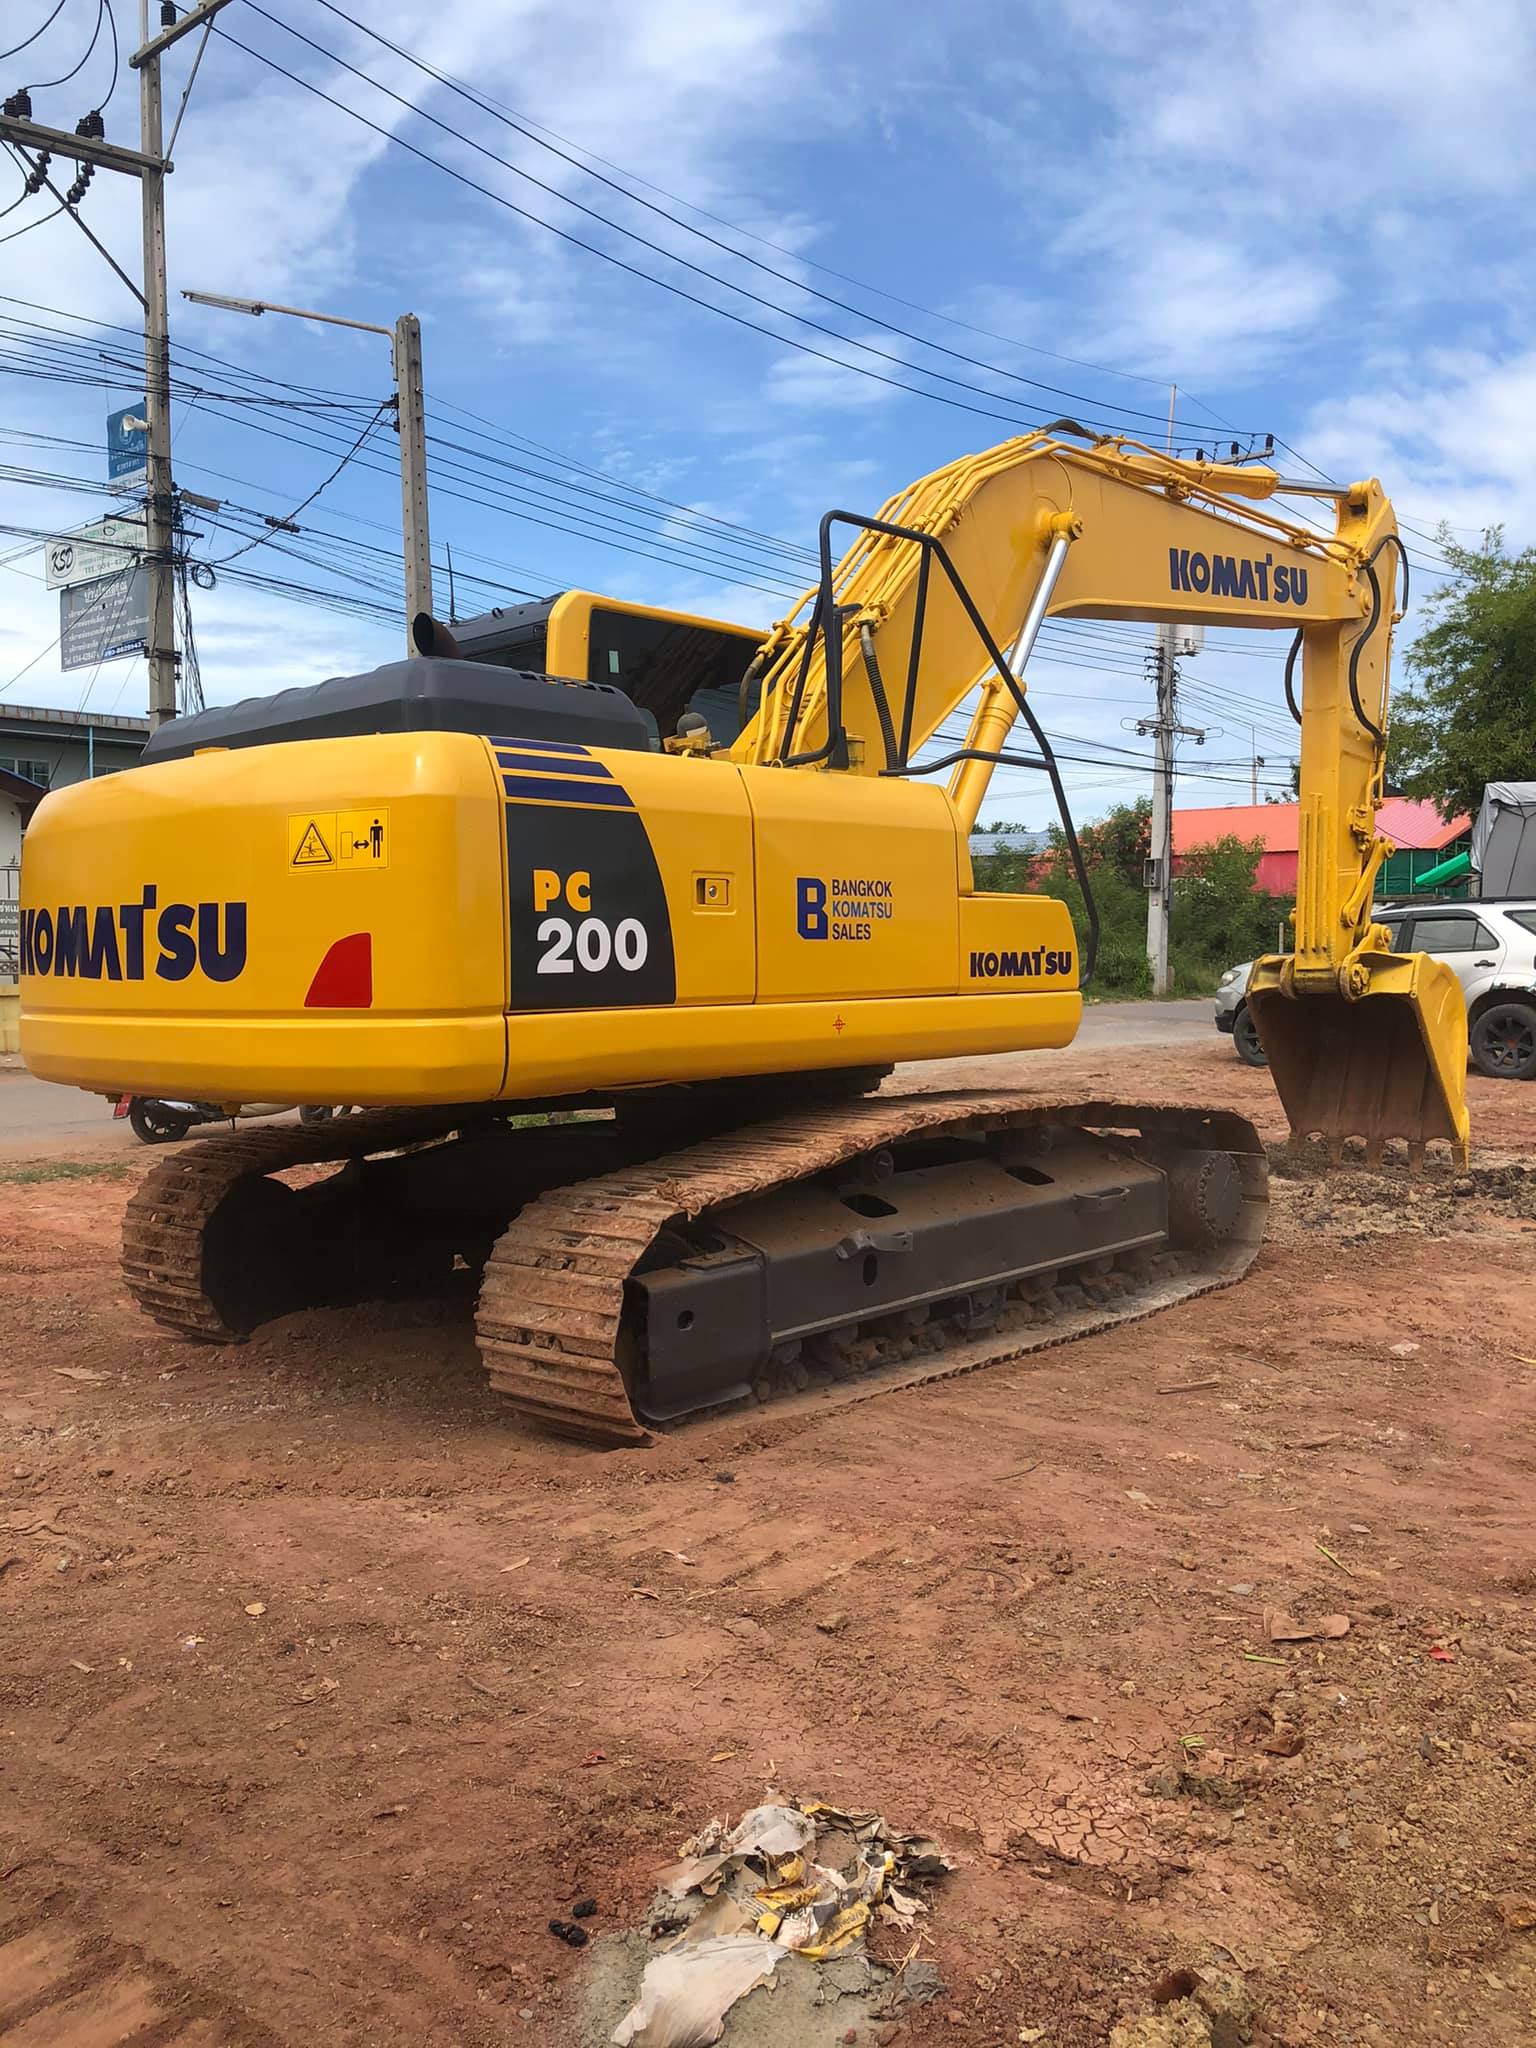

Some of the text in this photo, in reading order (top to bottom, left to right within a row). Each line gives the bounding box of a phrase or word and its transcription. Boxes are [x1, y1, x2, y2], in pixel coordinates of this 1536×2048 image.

[1169, 547, 1308, 606] KOMATSU
[533, 870, 592, 913] PC
[832, 879, 893, 898] BANGKOK
[832, 901, 893, 919] KOMATSU
[20, 885, 247, 982] KOMATSU
[536, 917, 649, 976] 200
[832, 922, 872, 941] SALES
[970, 945, 1072, 978] KOMATSU
